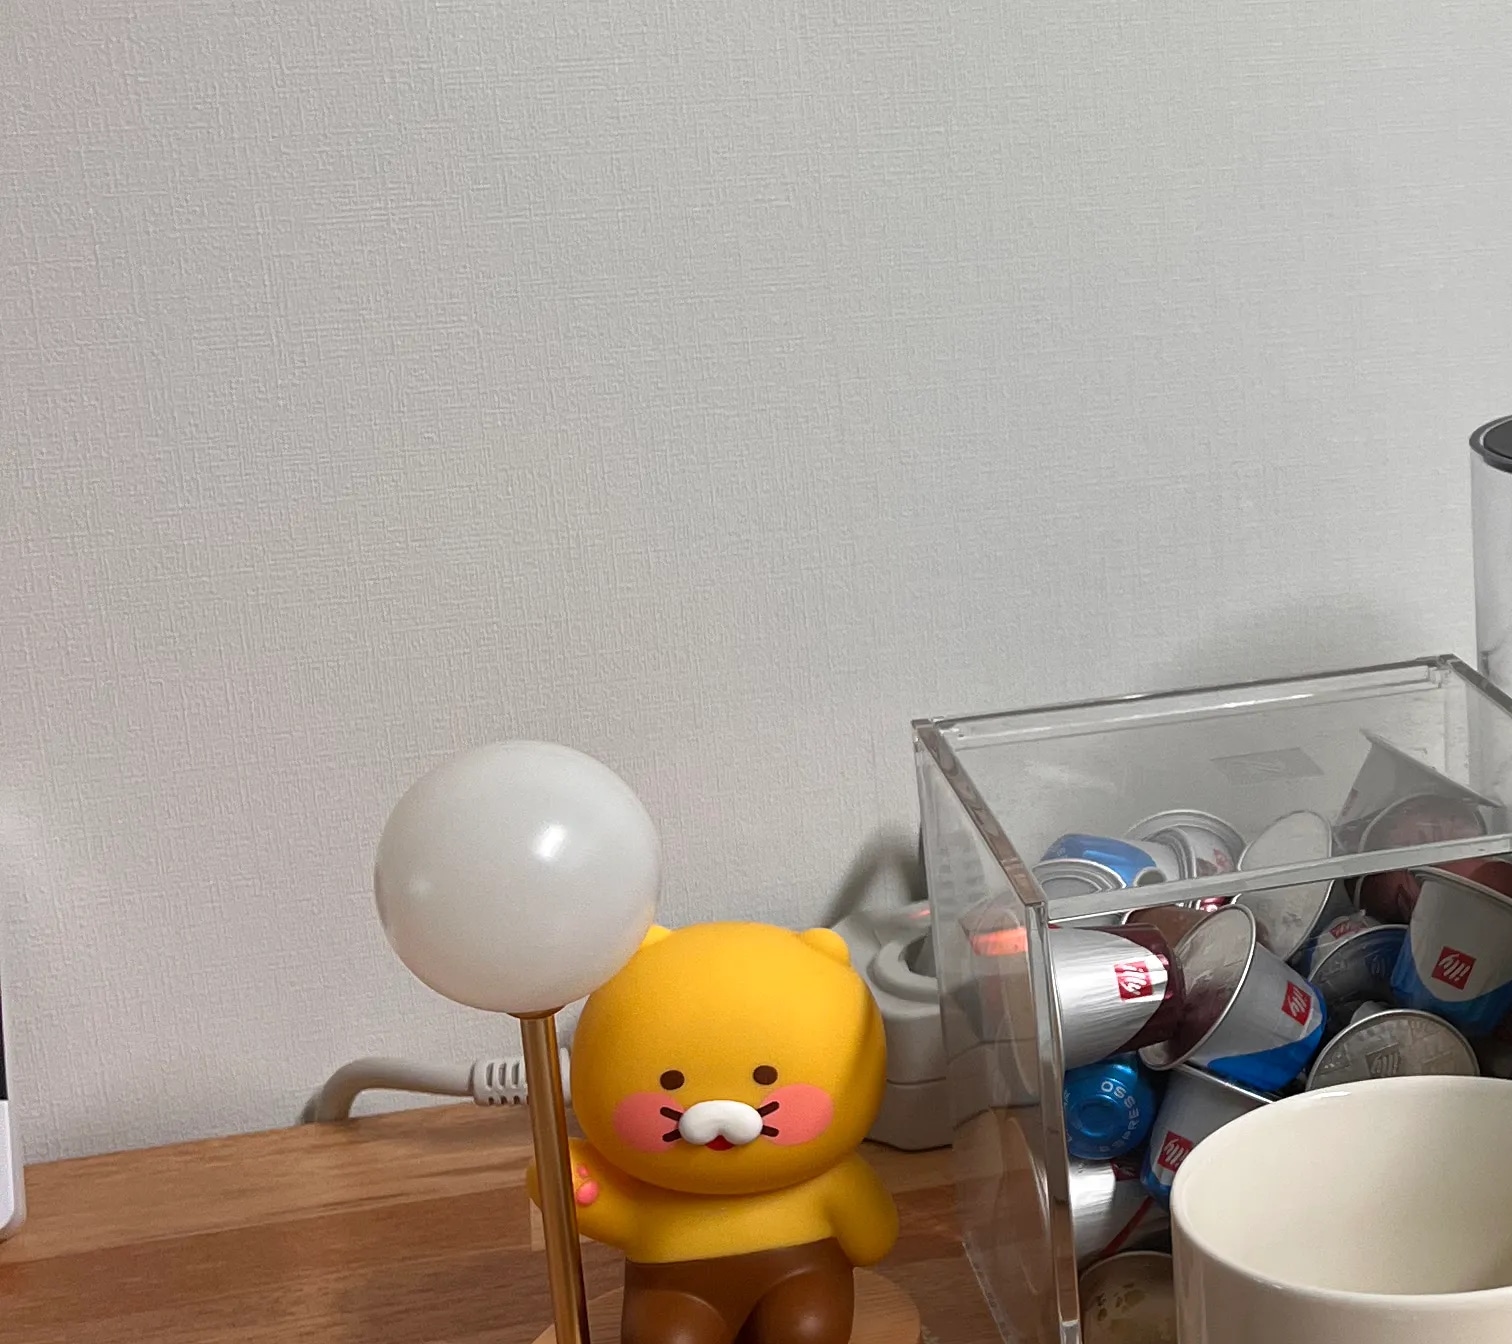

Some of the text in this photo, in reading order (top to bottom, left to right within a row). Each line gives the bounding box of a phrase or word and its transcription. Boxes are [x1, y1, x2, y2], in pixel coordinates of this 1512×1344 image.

[1117, 963, 1150, 996] illy
[1436, 952, 1472, 983] illy
[1287, 984, 1309, 1018] illy
[1163, 1137, 1191, 1167] illy
